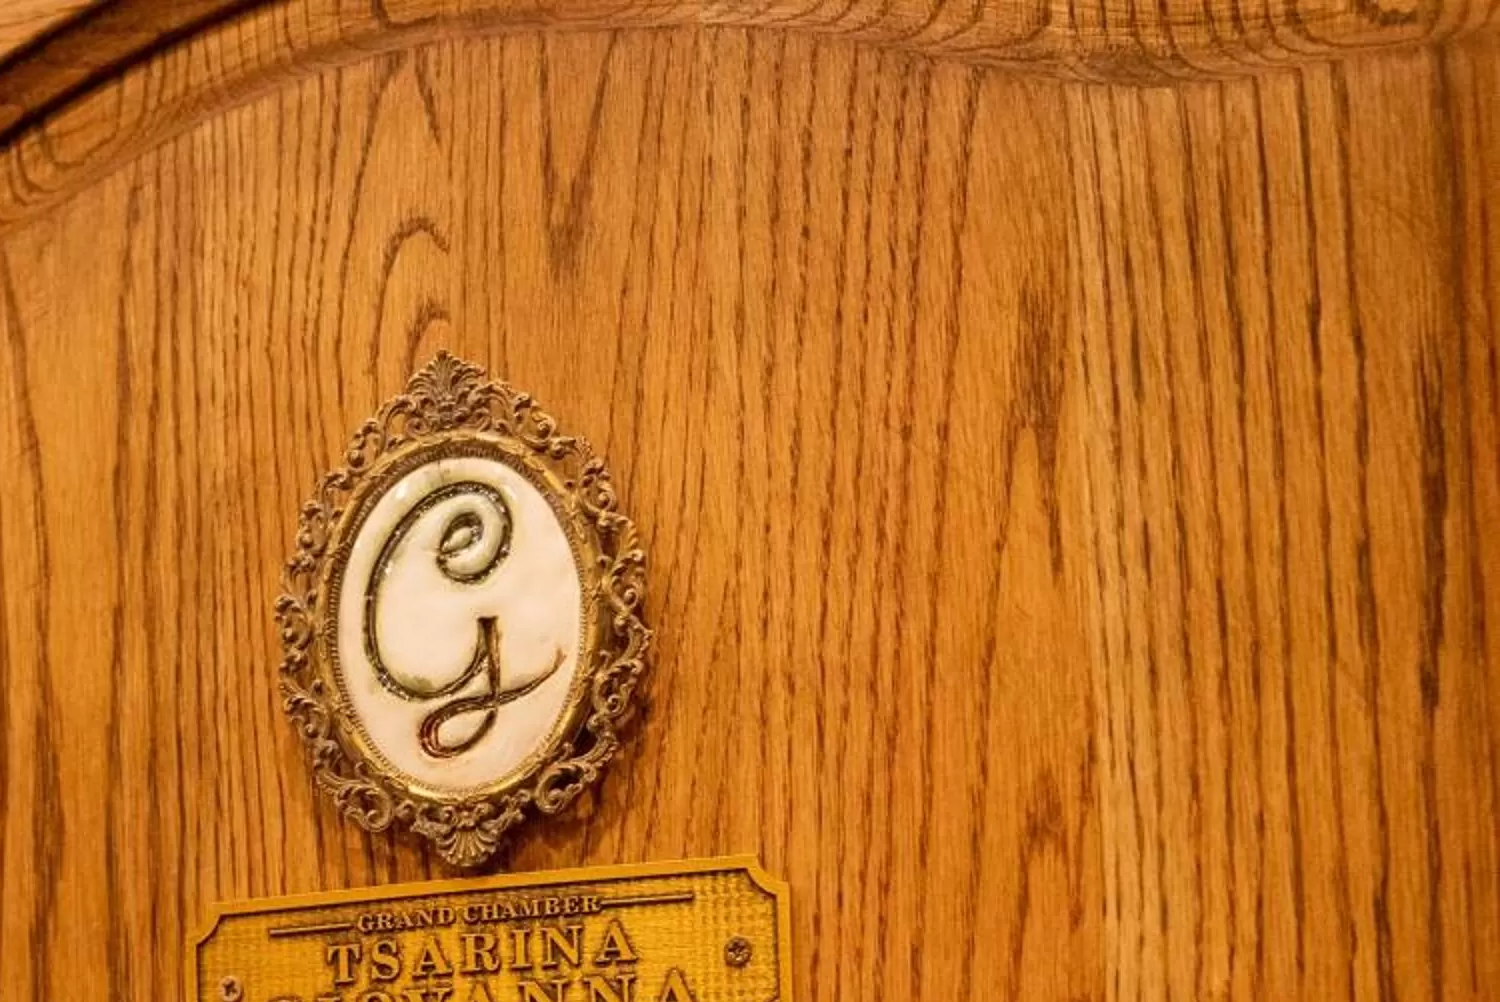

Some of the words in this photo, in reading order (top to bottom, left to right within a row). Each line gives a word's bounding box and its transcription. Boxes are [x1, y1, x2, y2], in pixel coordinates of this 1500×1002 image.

[356, 906, 455, 935] GRAND
[462, 894, 603, 924] CHAMBER
[325, 918, 640, 986] TSARINA
